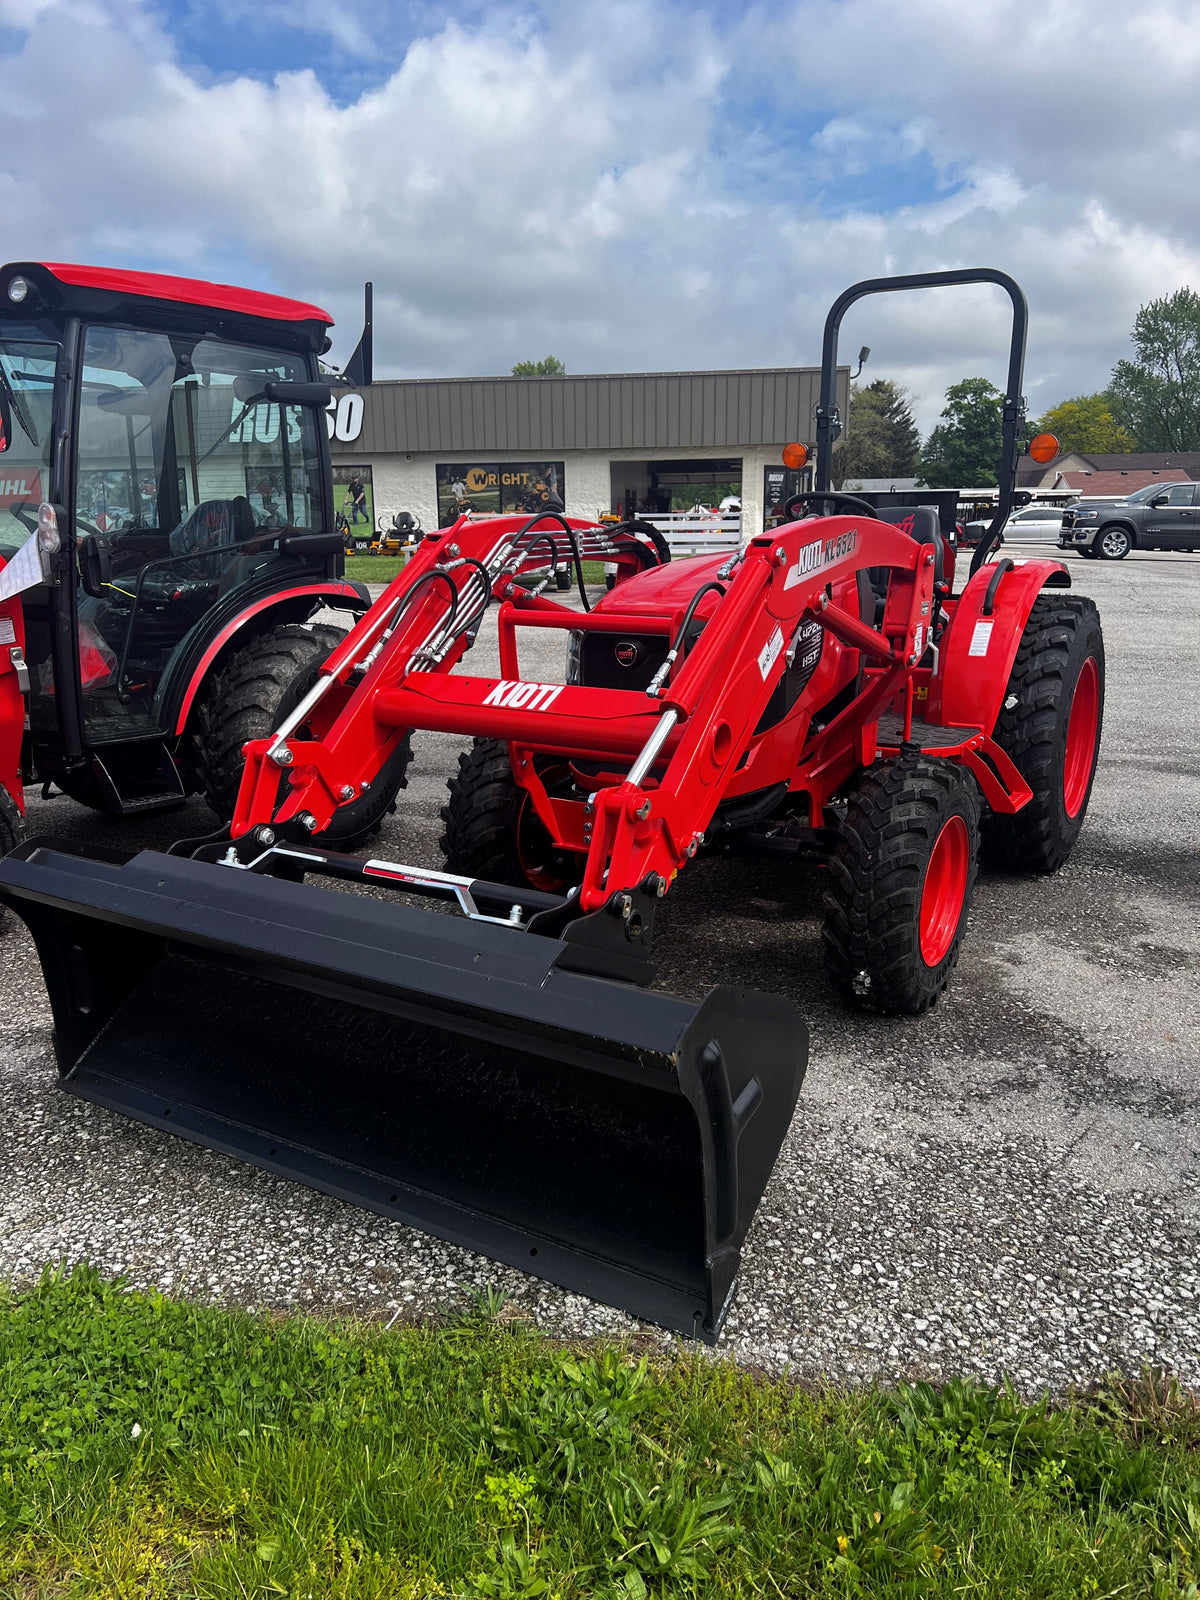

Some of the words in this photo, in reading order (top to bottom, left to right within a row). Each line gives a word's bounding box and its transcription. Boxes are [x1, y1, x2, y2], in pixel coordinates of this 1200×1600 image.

[0, 479, 32, 496] IHL
[472, 473, 529, 486] WRIGHT
[798, 538, 823, 577] KIOTI
[824, 538, 835, 564] KL
[836, 529, 857, 558] 5521
[481, 680, 565, 711] KIOTI
